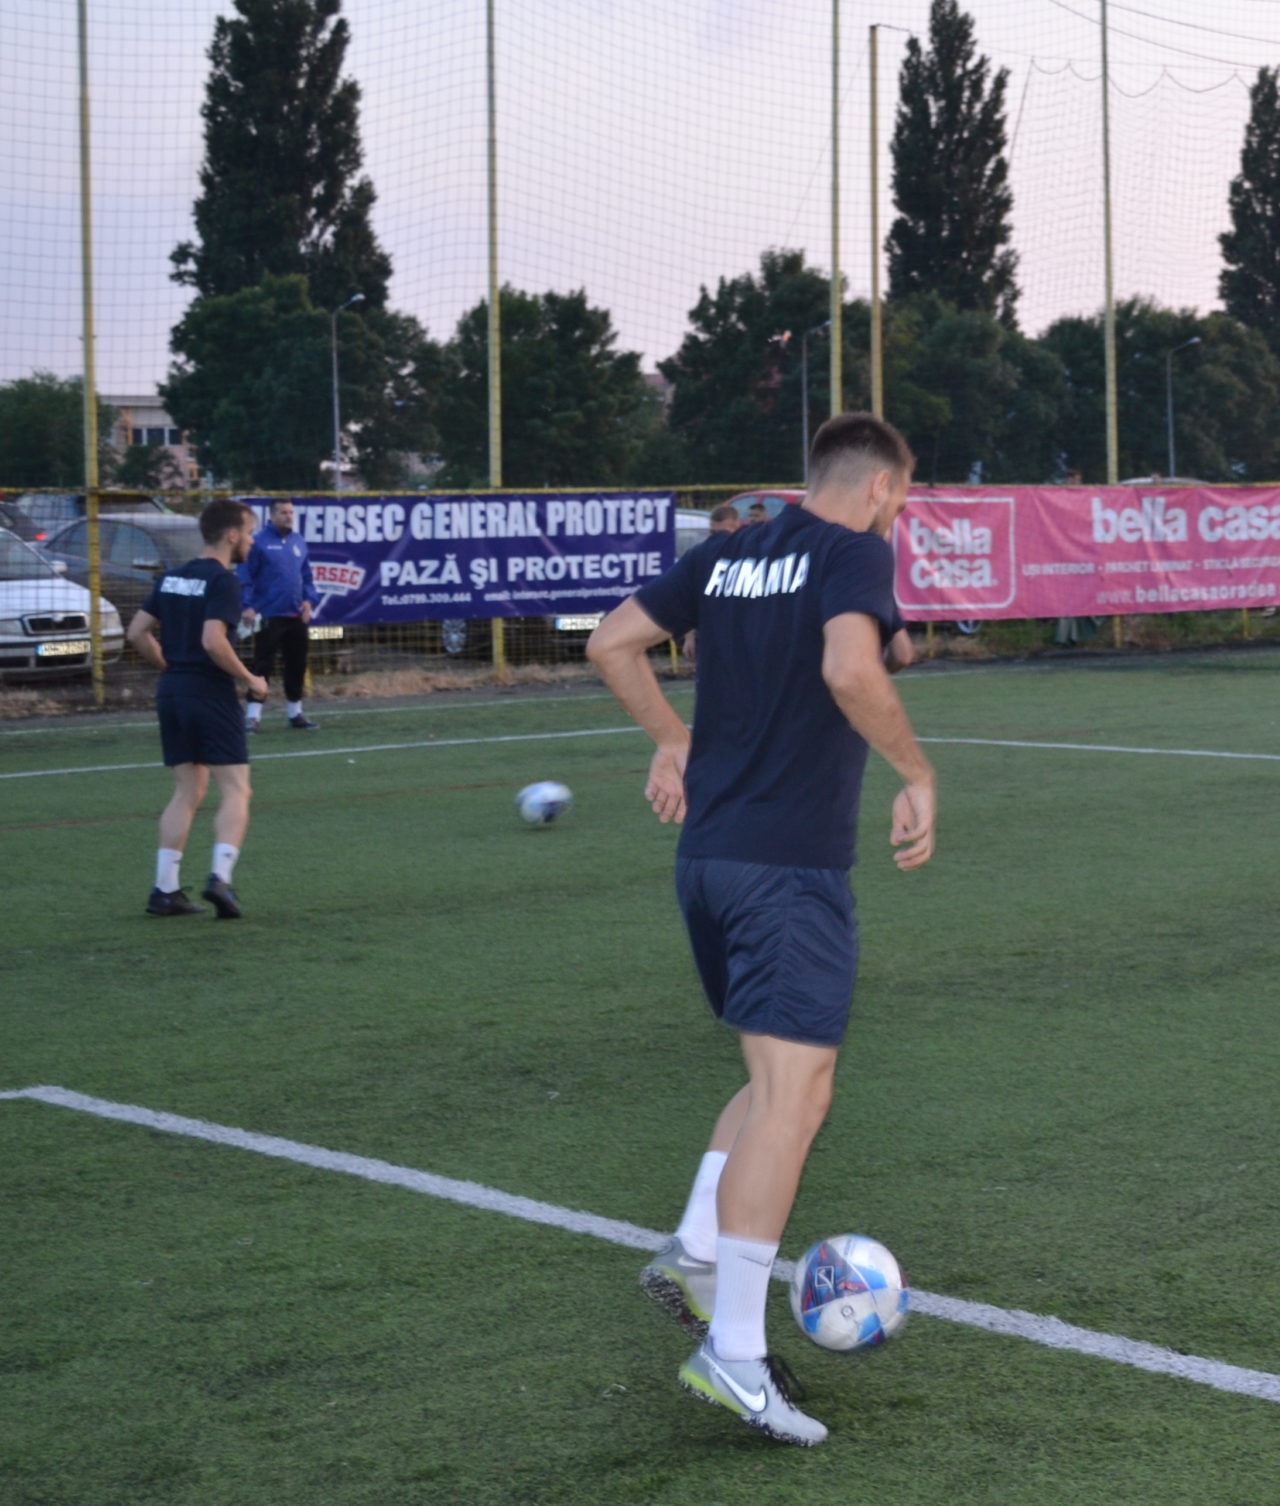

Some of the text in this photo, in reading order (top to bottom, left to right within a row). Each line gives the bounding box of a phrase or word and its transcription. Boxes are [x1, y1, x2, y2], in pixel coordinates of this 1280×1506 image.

[410, 501, 541, 540] GENERAL
[547, 498, 670, 536] PROTECT
[910, 518, 992, 555] bella
[1091, 497, 1188, 543] bella
[380, 554, 462, 586] PAZĂ
[910, 558, 994, 589] casa
